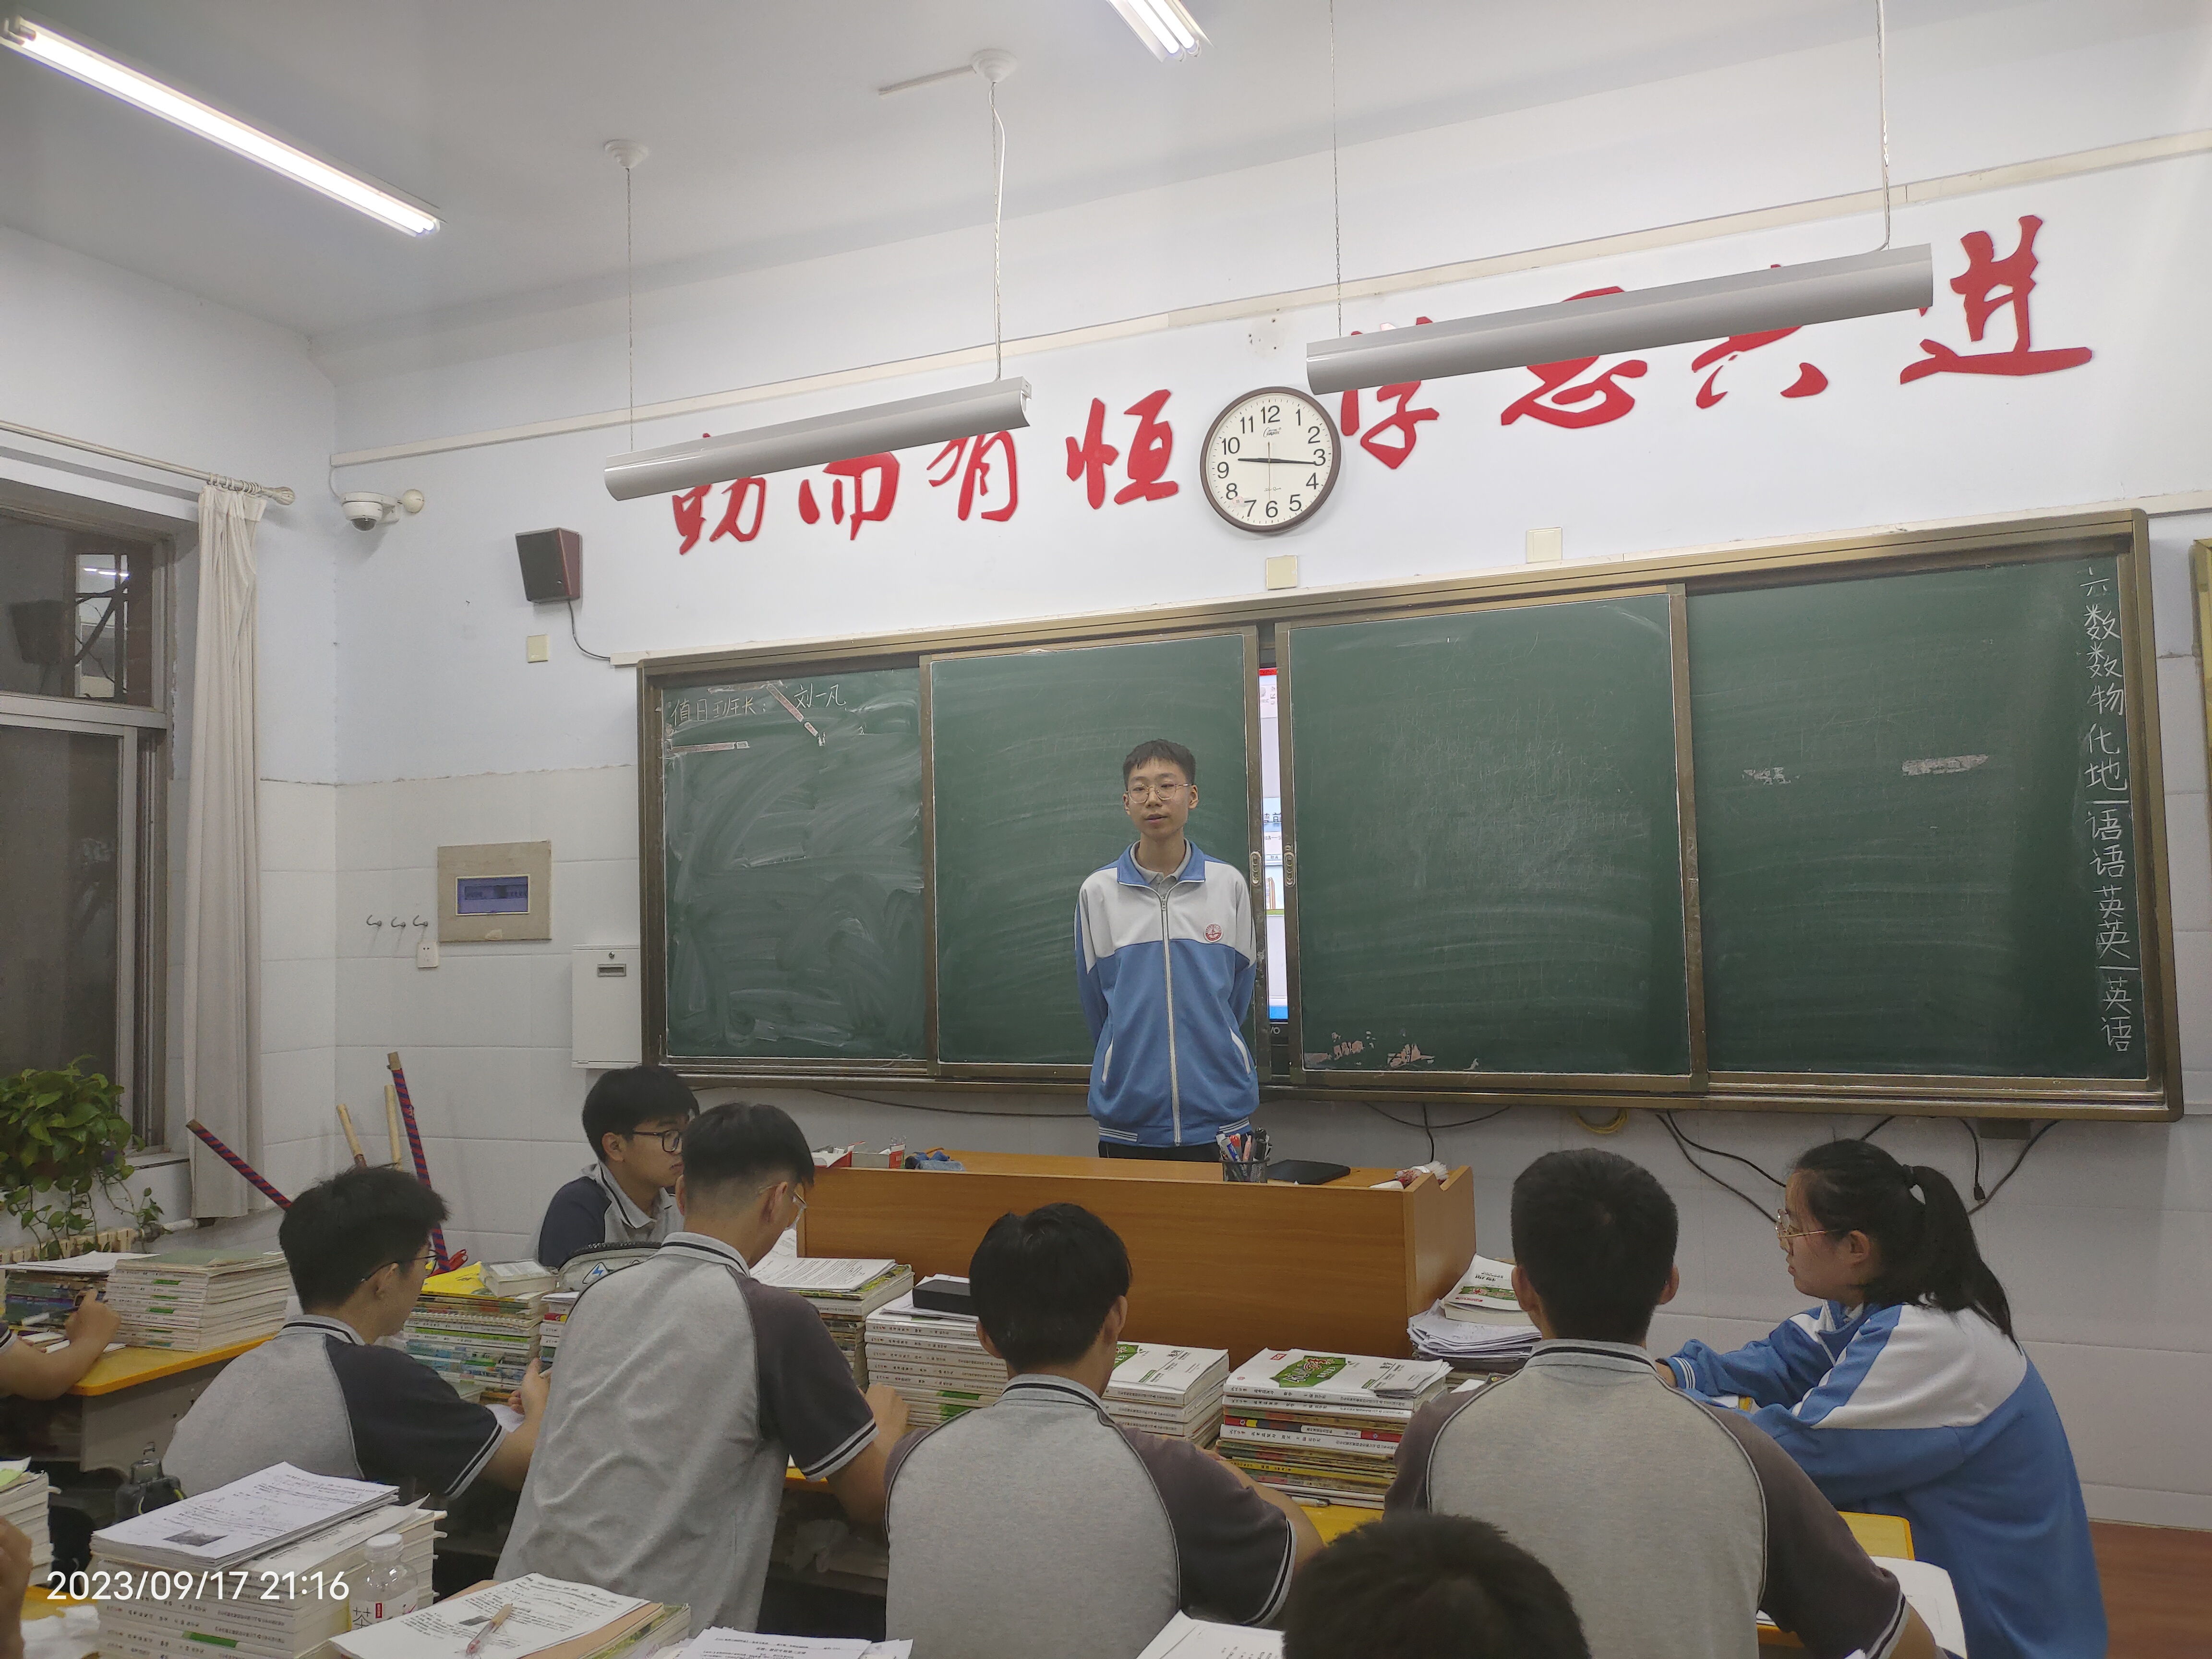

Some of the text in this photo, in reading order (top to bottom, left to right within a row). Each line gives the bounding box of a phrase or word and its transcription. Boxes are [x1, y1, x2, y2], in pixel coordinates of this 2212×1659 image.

[1261, 405, 1280, 424] 12
[1296, 409, 1301, 426] 1
[1240, 415, 1254, 434] 11
[1308, 426, 1320, 444] 2
[1222, 437, 1240, 455] 10
[1313, 448, 1326, 466] 3
[1217, 461, 1229, 479] 9
[1306, 472, 1319, 490] 4
[1226, 482, 1238, 500] 8
[1244, 499, 1257, 517] 7
[1265, 500, 1278, 518] 6
[1289, 493, 1302, 512] 5
[793, 683, 847, 708] 刘一凡
